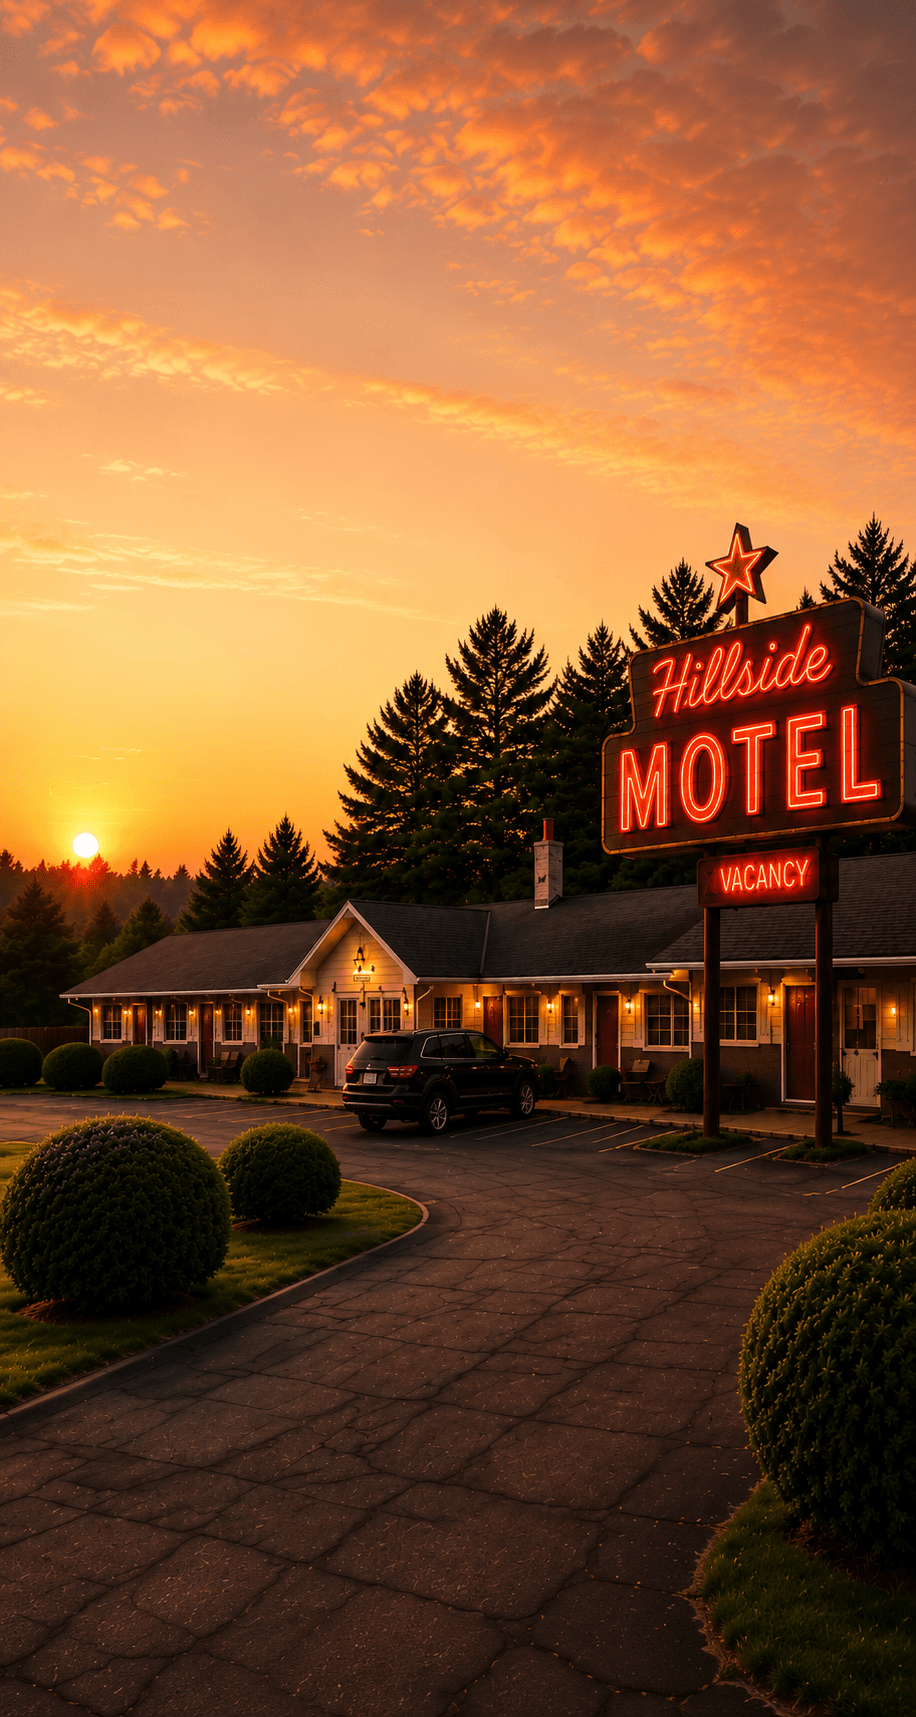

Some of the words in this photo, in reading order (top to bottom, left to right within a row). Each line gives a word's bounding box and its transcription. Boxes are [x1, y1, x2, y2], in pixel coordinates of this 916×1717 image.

[652, 624, 832, 718] Hillside
[619, 705, 883, 833] MOTEL
[720, 859, 810, 892] VACANCY
